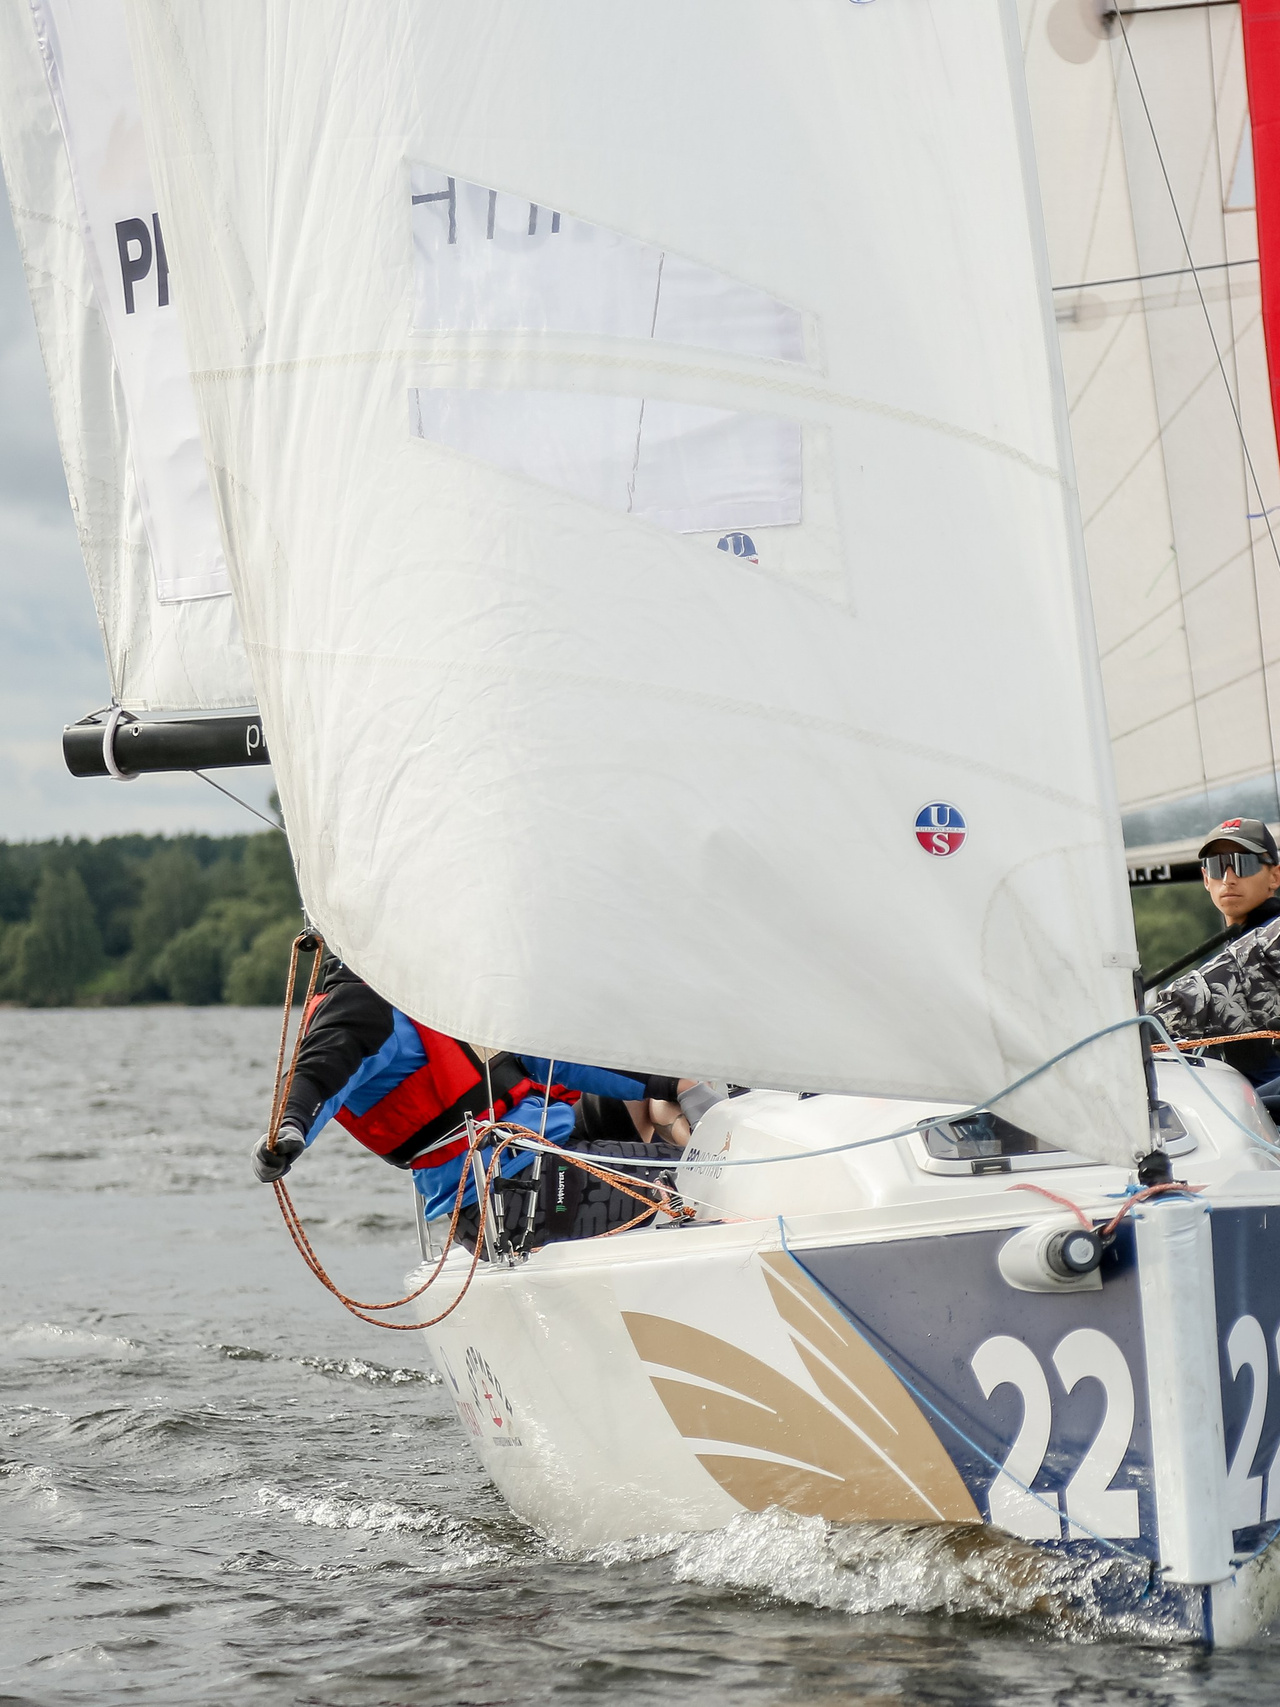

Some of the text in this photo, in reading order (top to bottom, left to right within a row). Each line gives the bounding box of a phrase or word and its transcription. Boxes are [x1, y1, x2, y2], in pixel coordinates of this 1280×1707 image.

[929, 806, 952, 827] U
[932, 832, 951, 855] S
[970, 1328, 1140, 1540] 22
